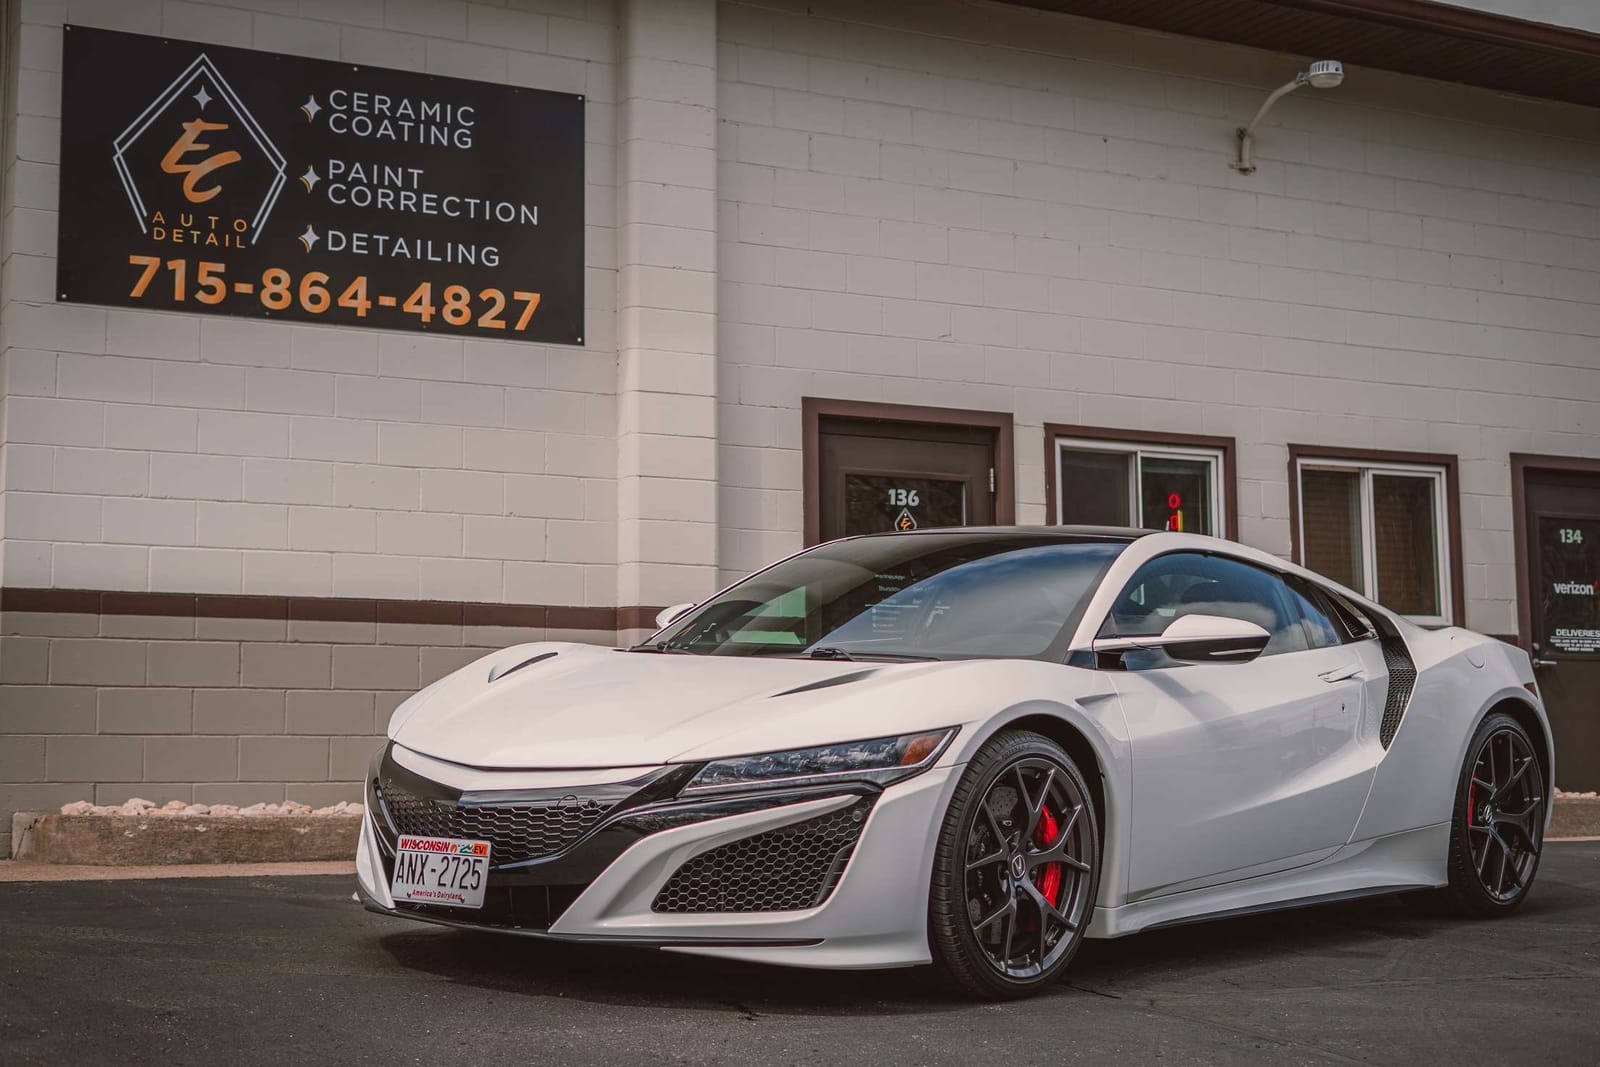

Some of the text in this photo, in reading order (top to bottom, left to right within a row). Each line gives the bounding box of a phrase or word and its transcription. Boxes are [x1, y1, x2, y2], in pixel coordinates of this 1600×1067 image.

[329, 89, 475, 127] CERAMIC
[329, 113, 472, 149] COATING
[160, 118, 242, 203] EC
[328, 159, 424, 189] PAINT
[328, 183, 538, 226] CORRECTION
[152, 210, 248, 232] AUTO
[153, 227, 246, 249] DETAIL
[327, 230, 499, 267] DETAILING
[128, 255, 541, 332] 715-864-4827
[888, 488, 920, 507] 136
[1559, 529, 1583, 544] 134
[1553, 581, 1594, 595] verizon
[1555, 628, 1600, 638] DELIVERIES
[401, 838, 450, 853] WISCONSIN
[396, 853, 483, 890] ANX-2725
[412, 889, 463, 900] America's Dairyland
